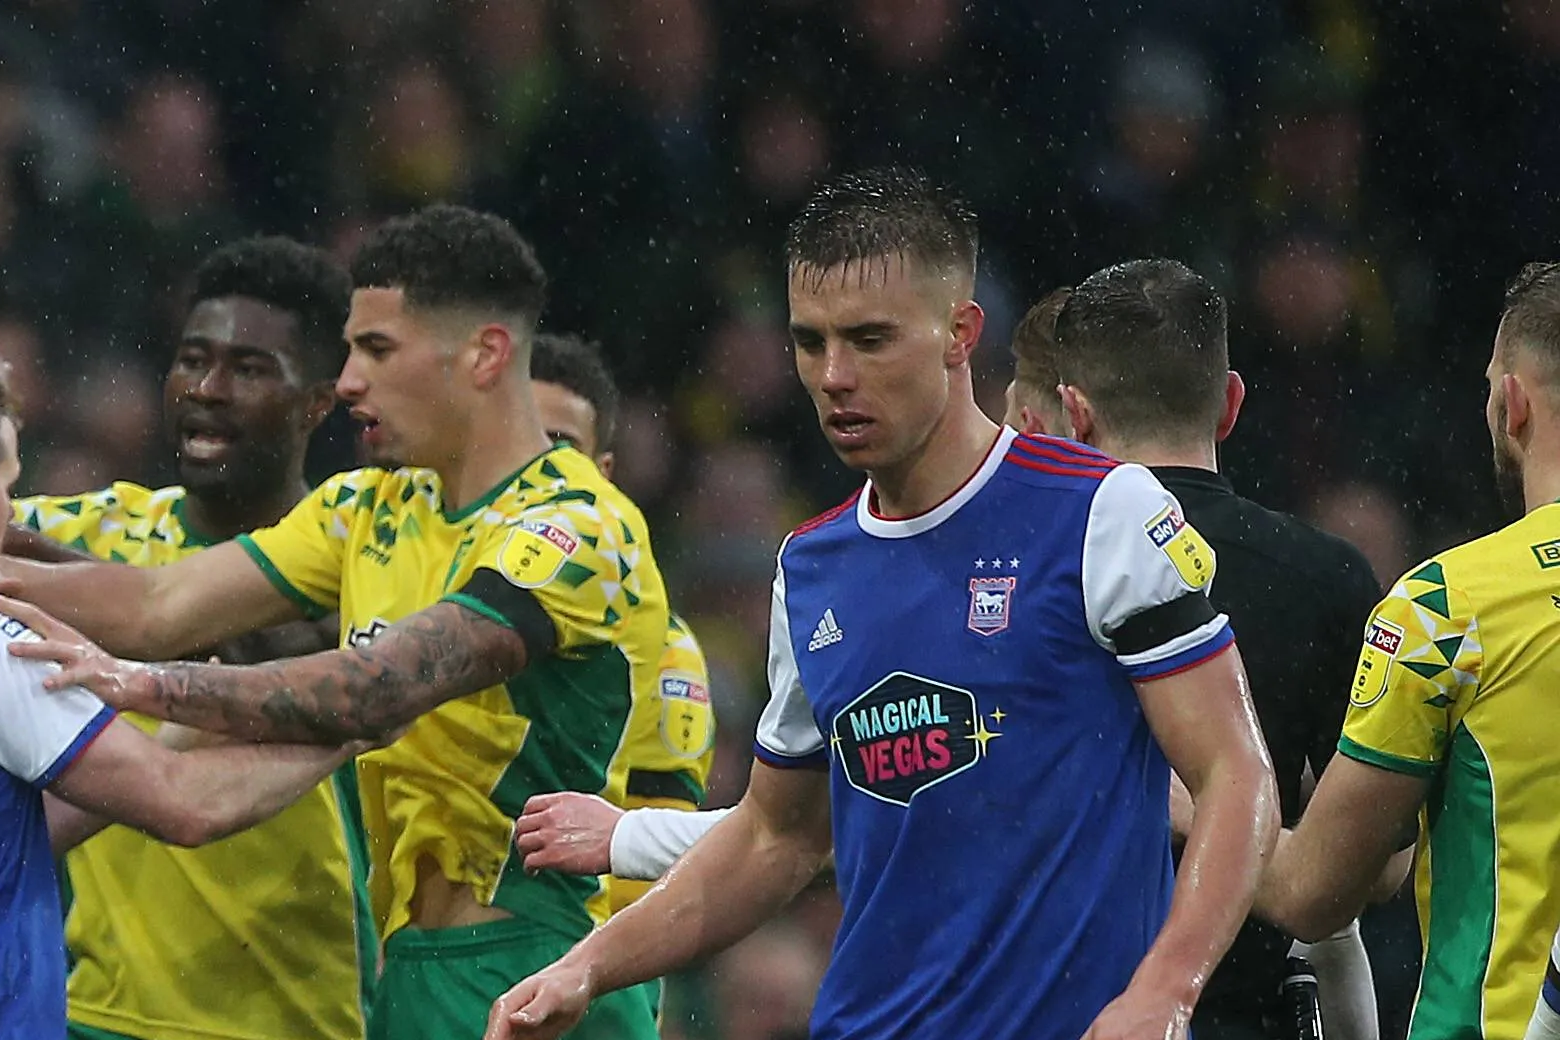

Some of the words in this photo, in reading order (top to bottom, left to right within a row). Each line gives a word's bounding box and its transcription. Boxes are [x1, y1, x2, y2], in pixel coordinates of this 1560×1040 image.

[1152, 520, 1175, 543] sky
[1376, 629, 1397, 650] bet
[849, 694, 949, 742] MAGICAL
[858, 729, 951, 784] VEGAS
